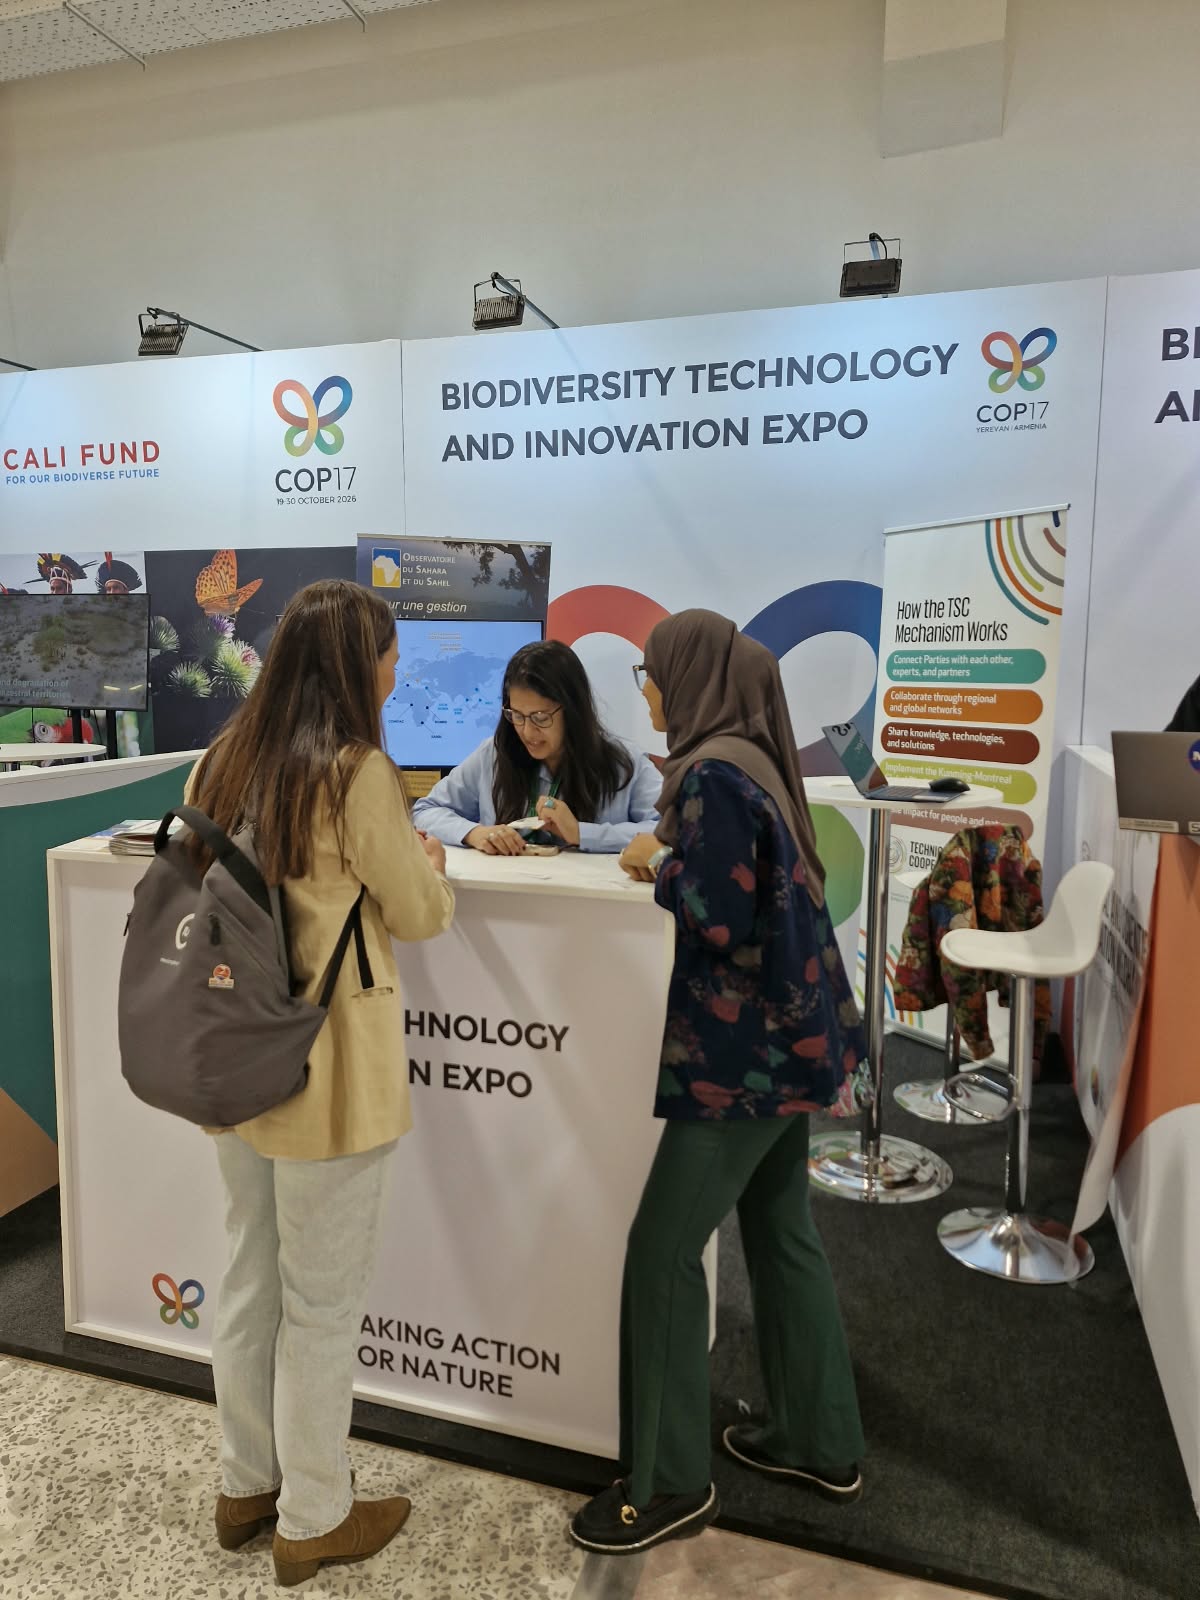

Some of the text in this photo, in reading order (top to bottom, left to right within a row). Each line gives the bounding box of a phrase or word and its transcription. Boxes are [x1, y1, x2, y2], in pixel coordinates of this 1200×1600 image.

[442, 343, 959, 410] BIODIVERSITY TECHNOLOGY
[976, 401, 1050, 423] COP17
[1154, 390, 1200, 424] A
[442, 408, 868, 462] AND INNOVATION EXPO
[3, 440, 160, 470] CALI FUND
[6, 468, 160, 484] FOR OUR BIODIVERSE FUTURE
[275, 466, 356, 493] COP17
[298, 496, 335, 504] OCTOBER
[336, 495, 356, 503] 2026
[416, 565, 447, 575] SAHARA
[426, 578, 450, 587] SAHEL
[402, 602, 424, 610] une
[426, 602, 467, 614] gestion
[896, 597, 970, 620] How the TSC
[895, 620, 1008, 642] Mechanism Works
[894, 655, 1014, 665] Connect Parties with each other,
[892, 668, 970, 678] experts, and partners
[890, 691, 996, 706] Collaborate through regional
[890, 703, 962, 714] and global networks
[887, 739, 935, 750] and solutions
[888, 726, 1005, 745] Share knowledge, technologies,
[885, 762, 924, 774] Implement
[924, 766, 936, 776] the
[929, 810, 940, 820] for
[941, 813, 968, 824] people
[404, 1009, 569, 1052] HNOLOGY
[443, 1062, 532, 1098] EXPO
[360, 1314, 560, 1376] AKING ACTION
[358, 1345, 513, 1398] OR NATURE
